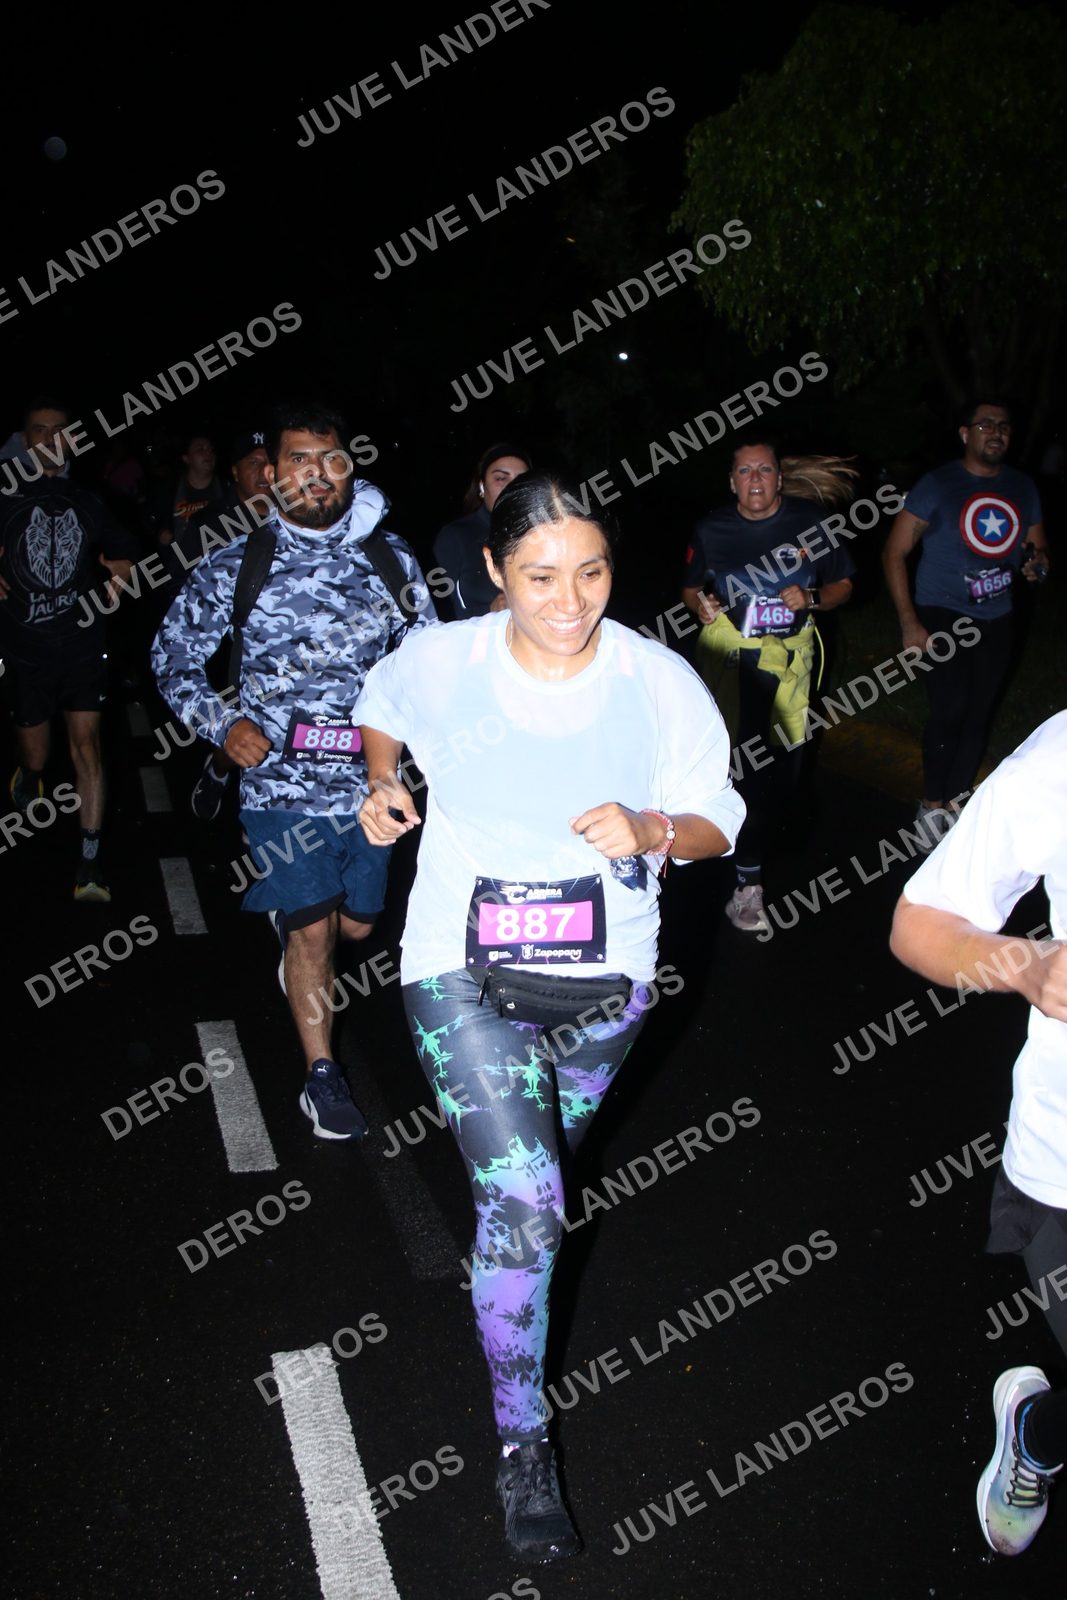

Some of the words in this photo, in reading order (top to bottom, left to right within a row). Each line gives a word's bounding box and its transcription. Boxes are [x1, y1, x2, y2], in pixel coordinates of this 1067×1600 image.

[975, 572, 1011, 595] 1656
[751, 607, 795, 625] 1465
[304, 728, 354, 750] 888
[496, 906, 576, 942] 887
